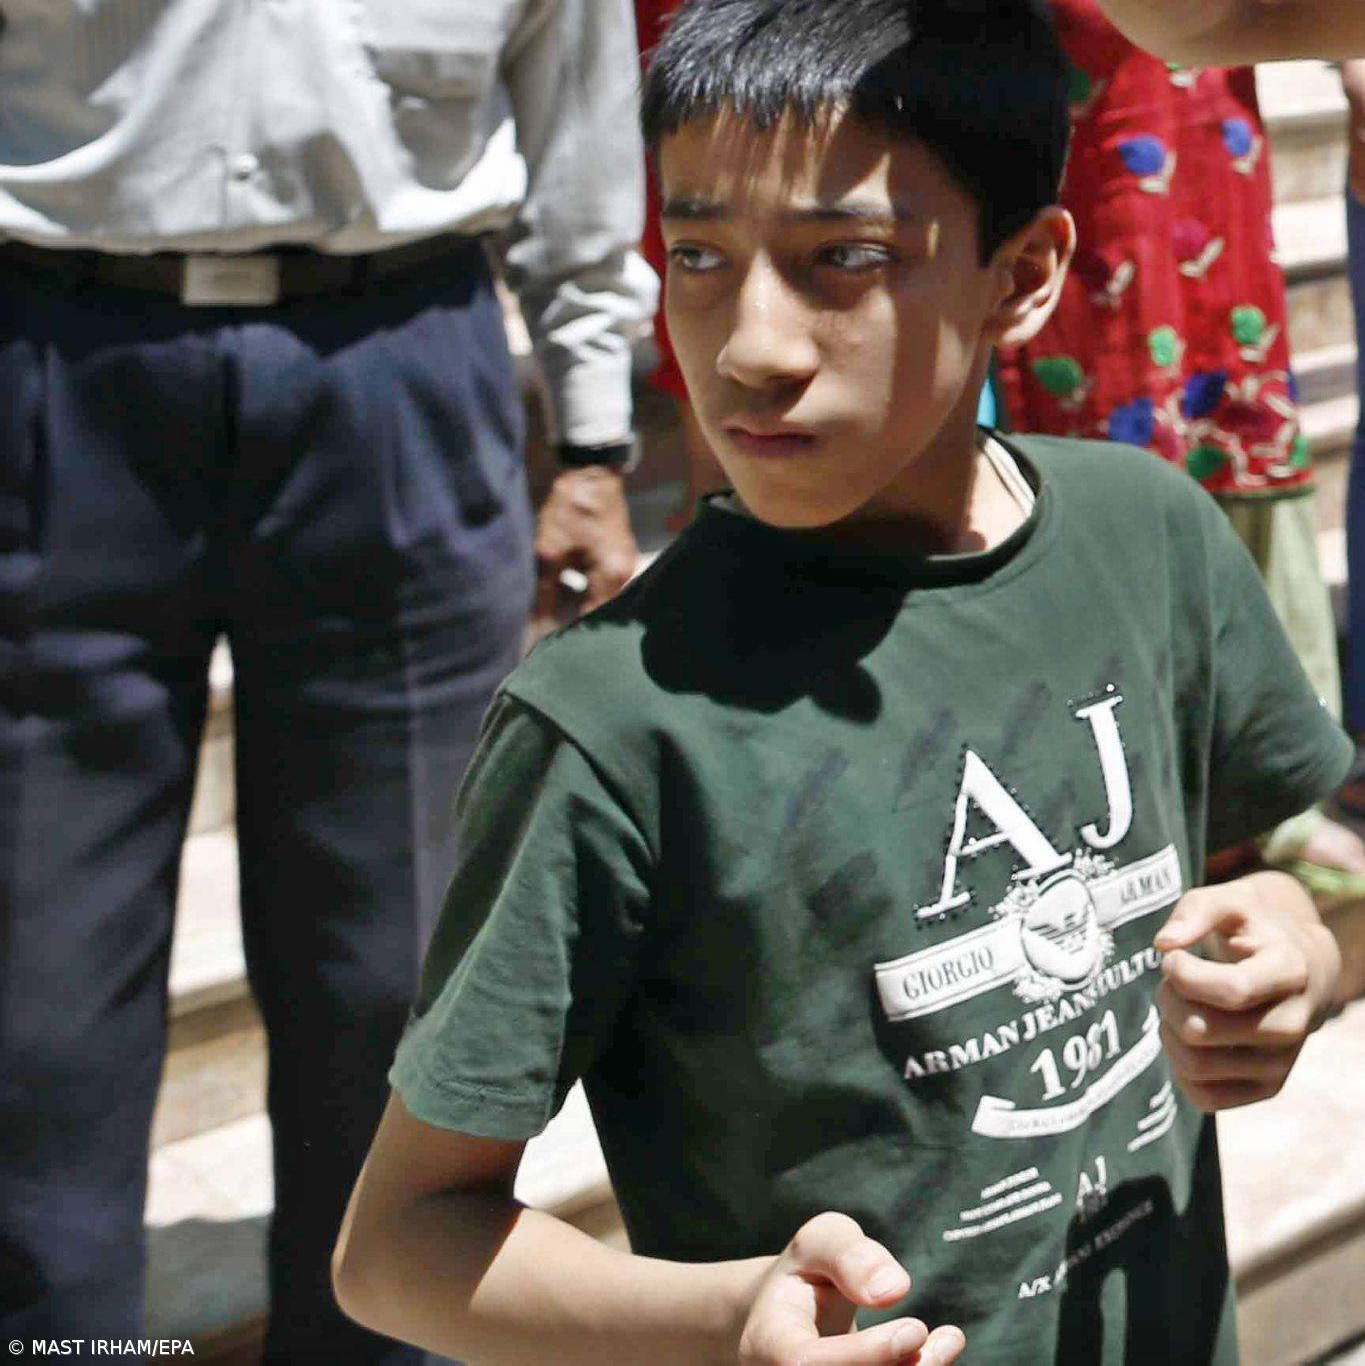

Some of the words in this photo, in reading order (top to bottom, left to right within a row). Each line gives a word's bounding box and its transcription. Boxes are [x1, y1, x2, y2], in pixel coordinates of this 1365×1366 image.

[914, 687, 1134, 924] AJ
[902, 945, 995, 1001] GIORGIO
[1030, 1008, 1122, 1102] 1981
